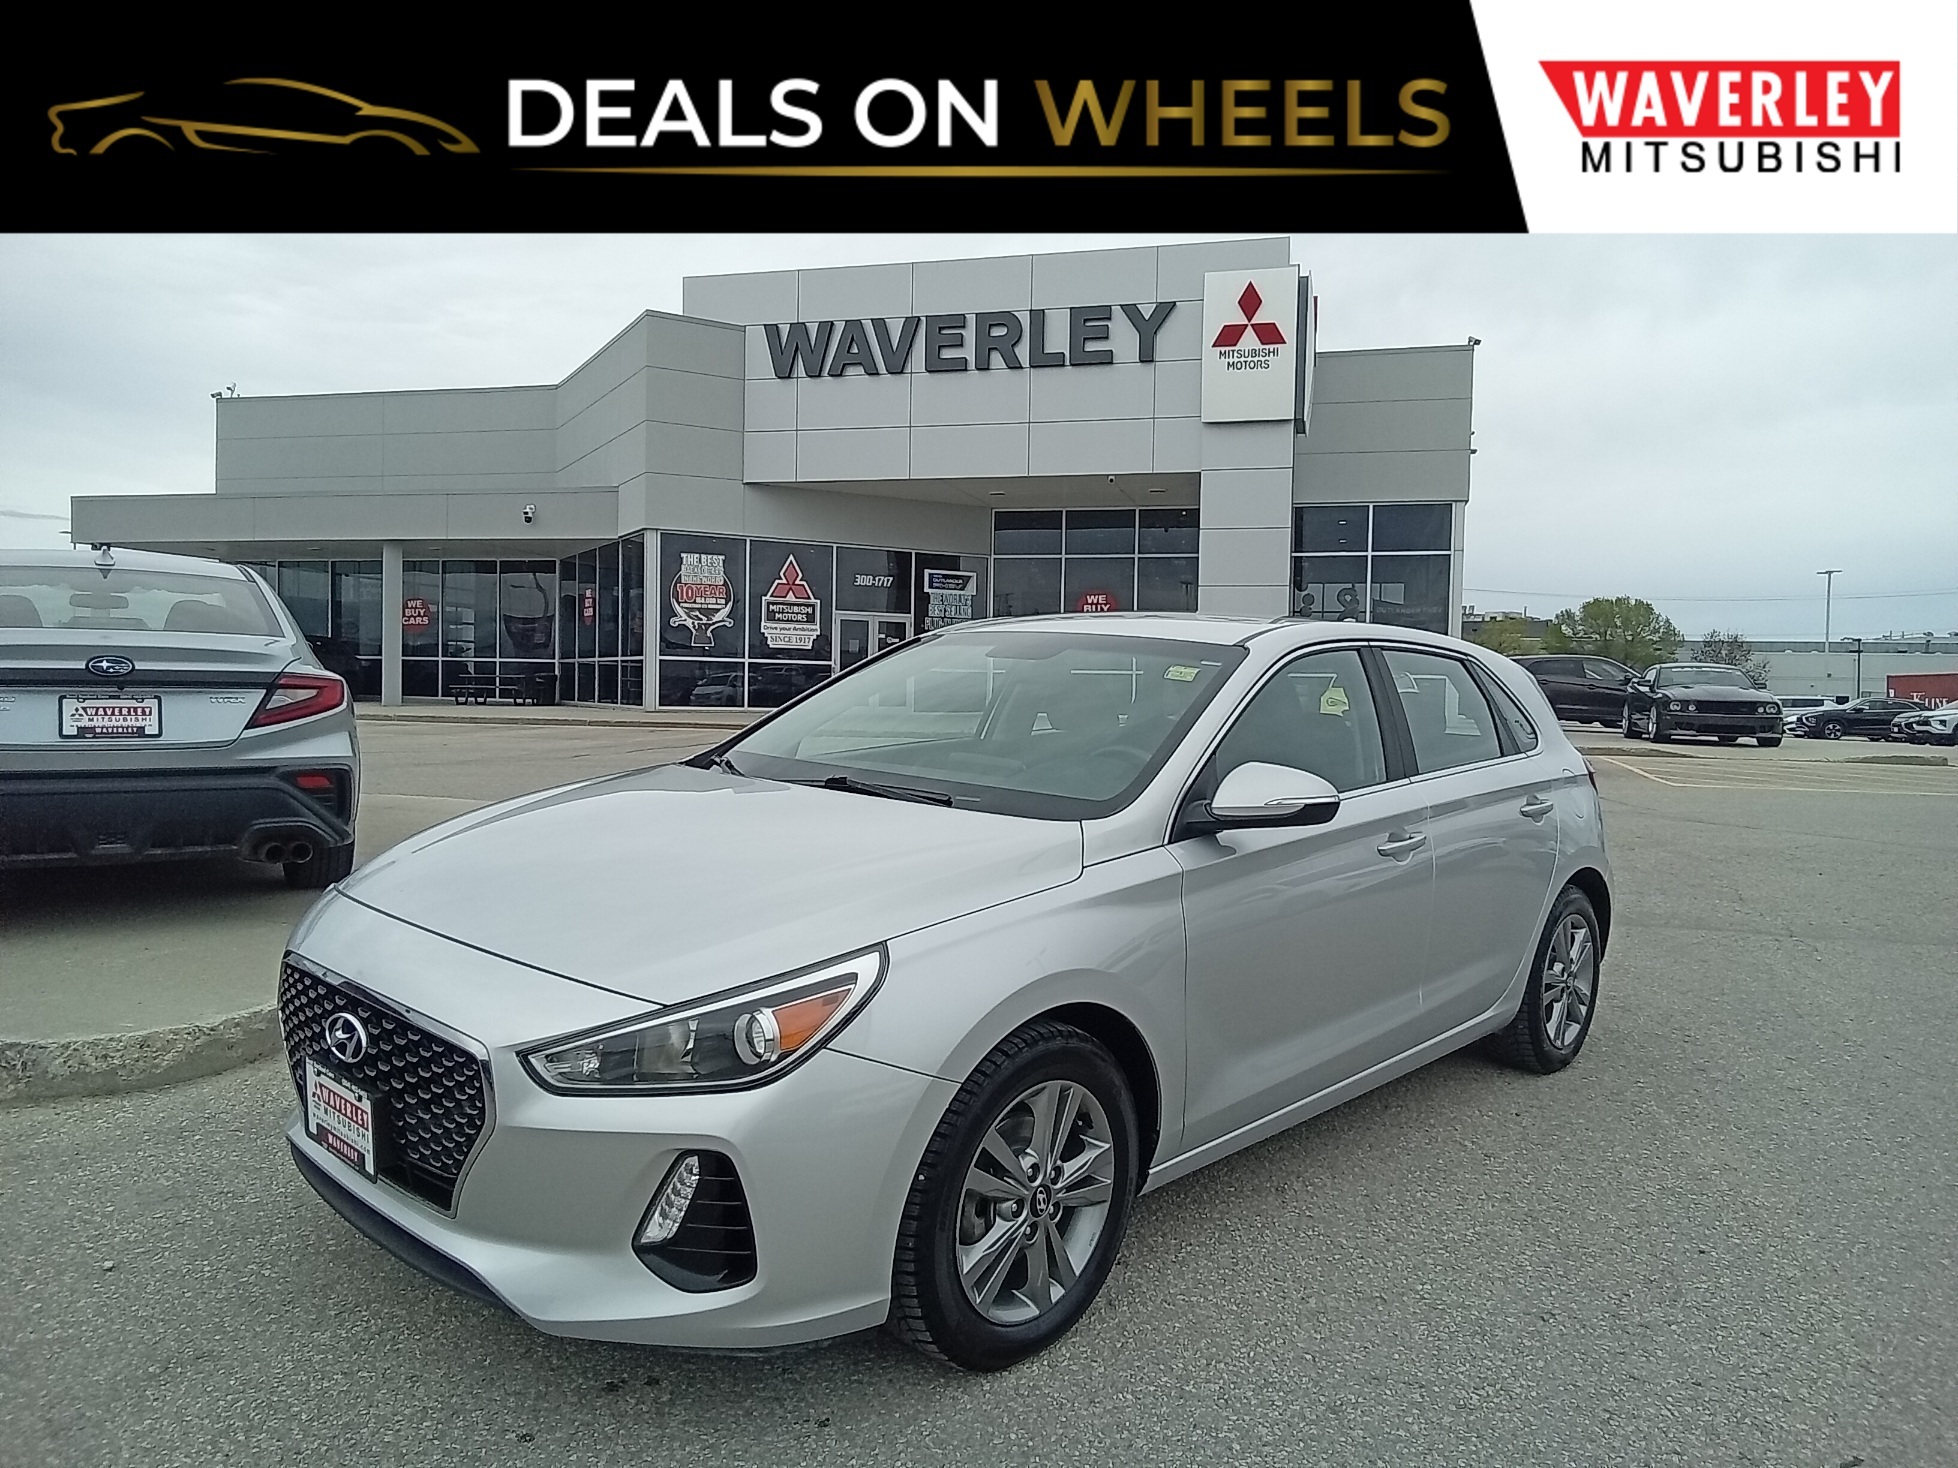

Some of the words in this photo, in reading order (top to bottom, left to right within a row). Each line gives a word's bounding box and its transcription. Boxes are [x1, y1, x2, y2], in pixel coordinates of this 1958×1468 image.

[764, 301, 1177, 379] WAVERLEY
[1219, 347, 1279, 360] MITSUBISHI
[1226, 360, 1270, 371] MOTORS
[681, 553, 700, 566] THE
[700, 554, 725, 567] BEST
[853, 574, 894, 587] 300-1717
[677, 584, 695, 602] 10
[694, 585, 726, 598] YEAR
[1086, 595, 1107, 604] WE
[407, 600, 423, 608] WE
[769, 604, 813, 614] MITSUBISHI
[405, 608, 426, 616] BUY
[775, 613, 807, 621] MOTORS
[929, 604, 945, 617] BEST
[945, 605, 972, 618] SELLING
[402, 616, 429, 625] CARS
[86, 707, 151, 716] WAVERLEY
[321, 1086, 368, 1129] WAVERLEY
[323, 1105, 370, 1144] MITSUBISHI
[327, 1132, 358, 1162] WAVERLEY
